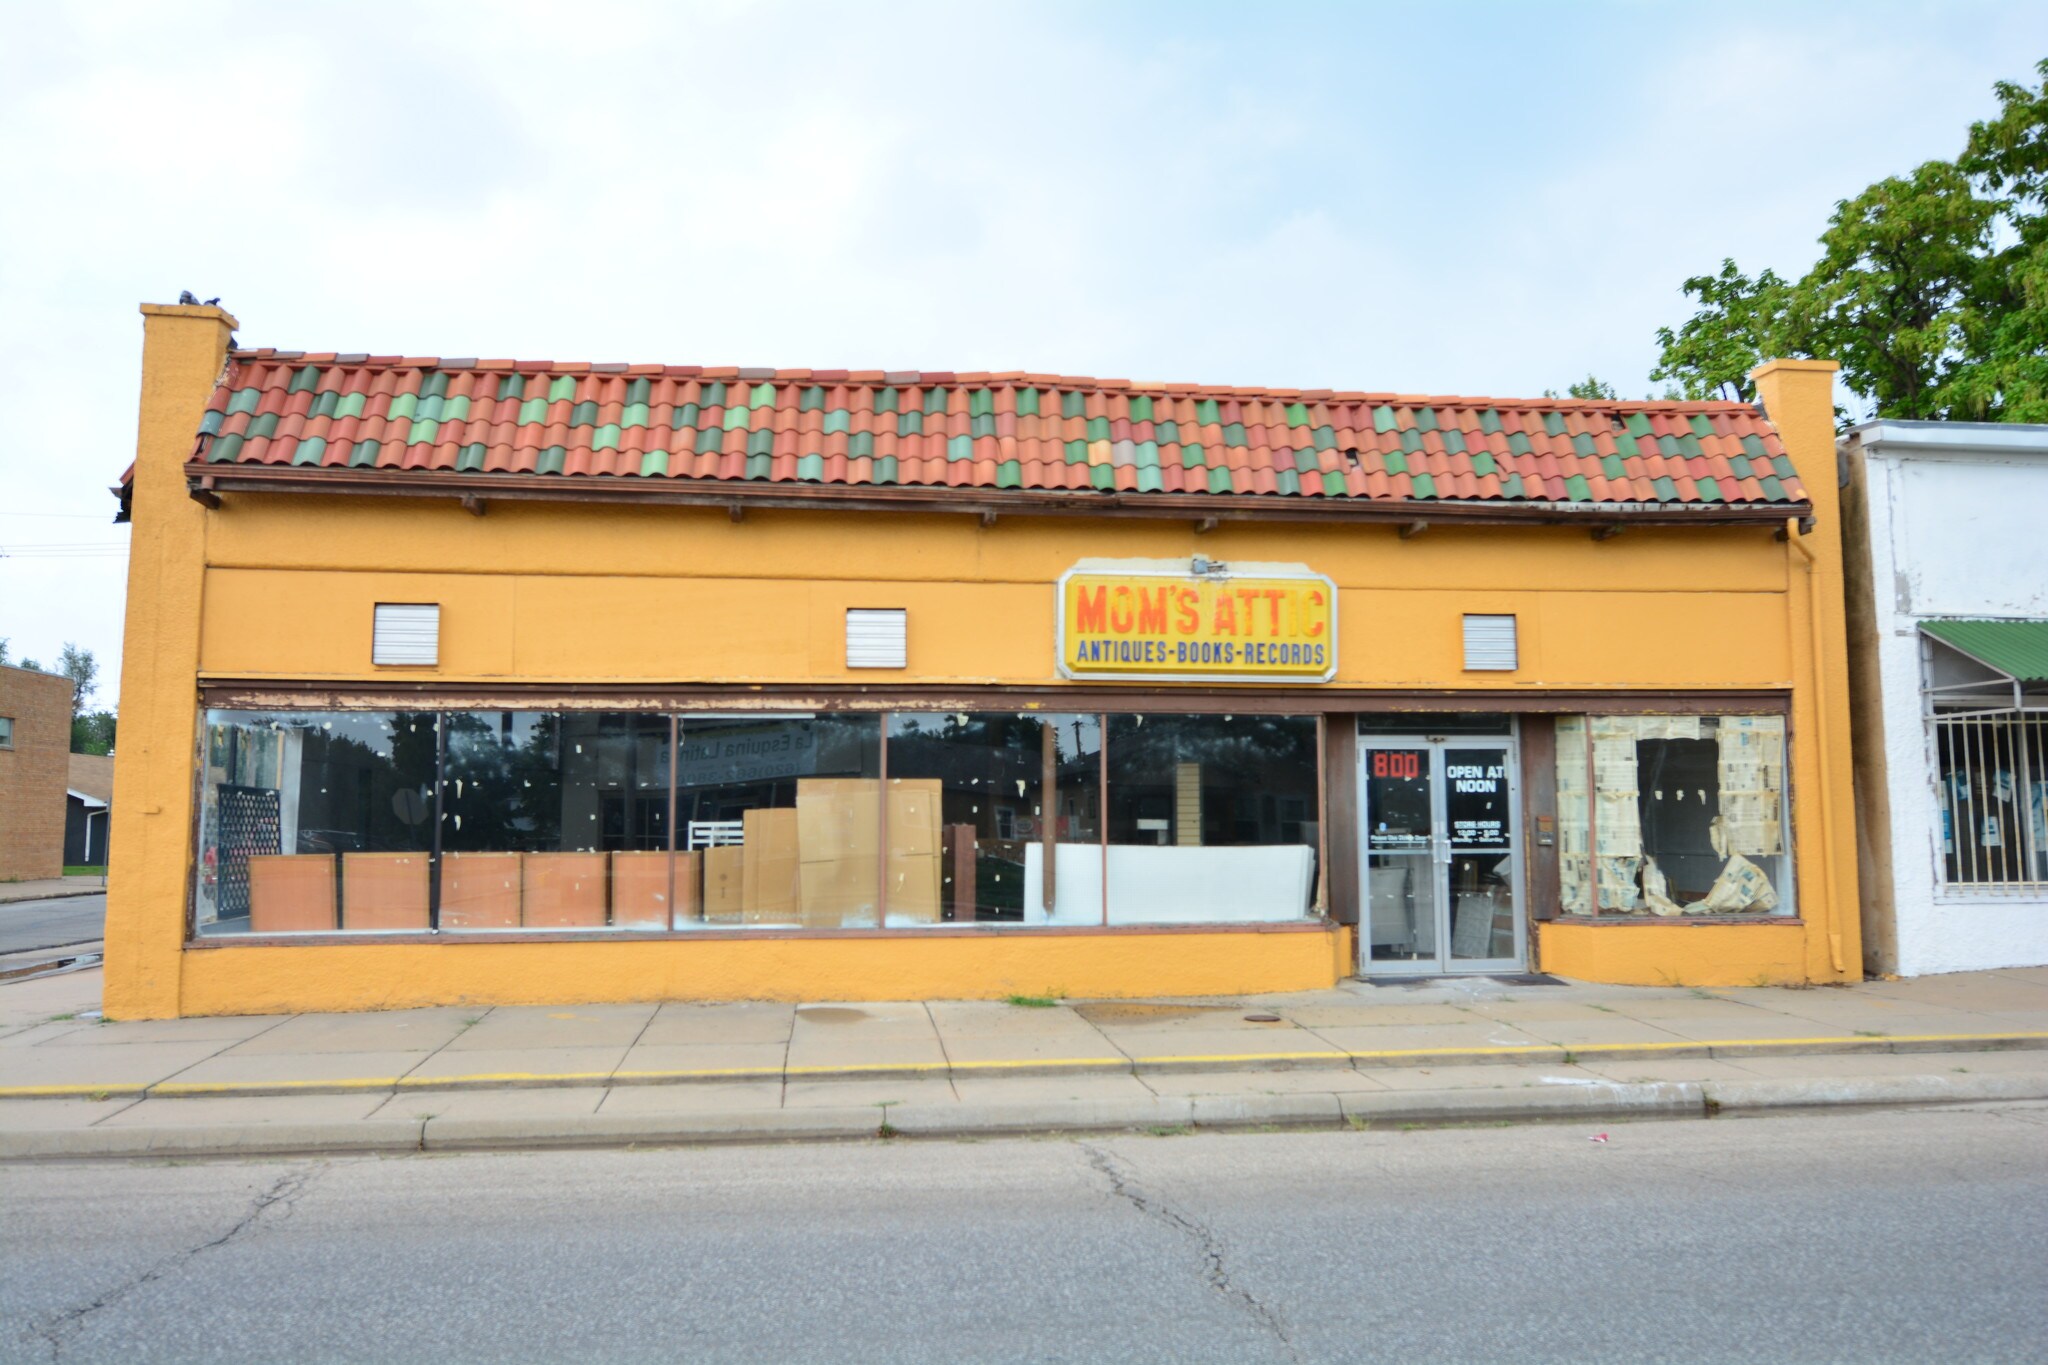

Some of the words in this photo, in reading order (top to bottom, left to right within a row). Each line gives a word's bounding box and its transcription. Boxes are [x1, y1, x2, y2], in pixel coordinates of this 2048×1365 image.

[1076, 585, 1200, 635] MOM'S
[1211, 589, 1324, 637] ATTIC
[1374, 753, 1419, 777] 800
[1447, 766, 1483, 778] OPEN
[1487, 766, 1505, 778] AT
[1456, 780, 1496, 792] NOON
[1477, 821, 1501, 829] HOURS
